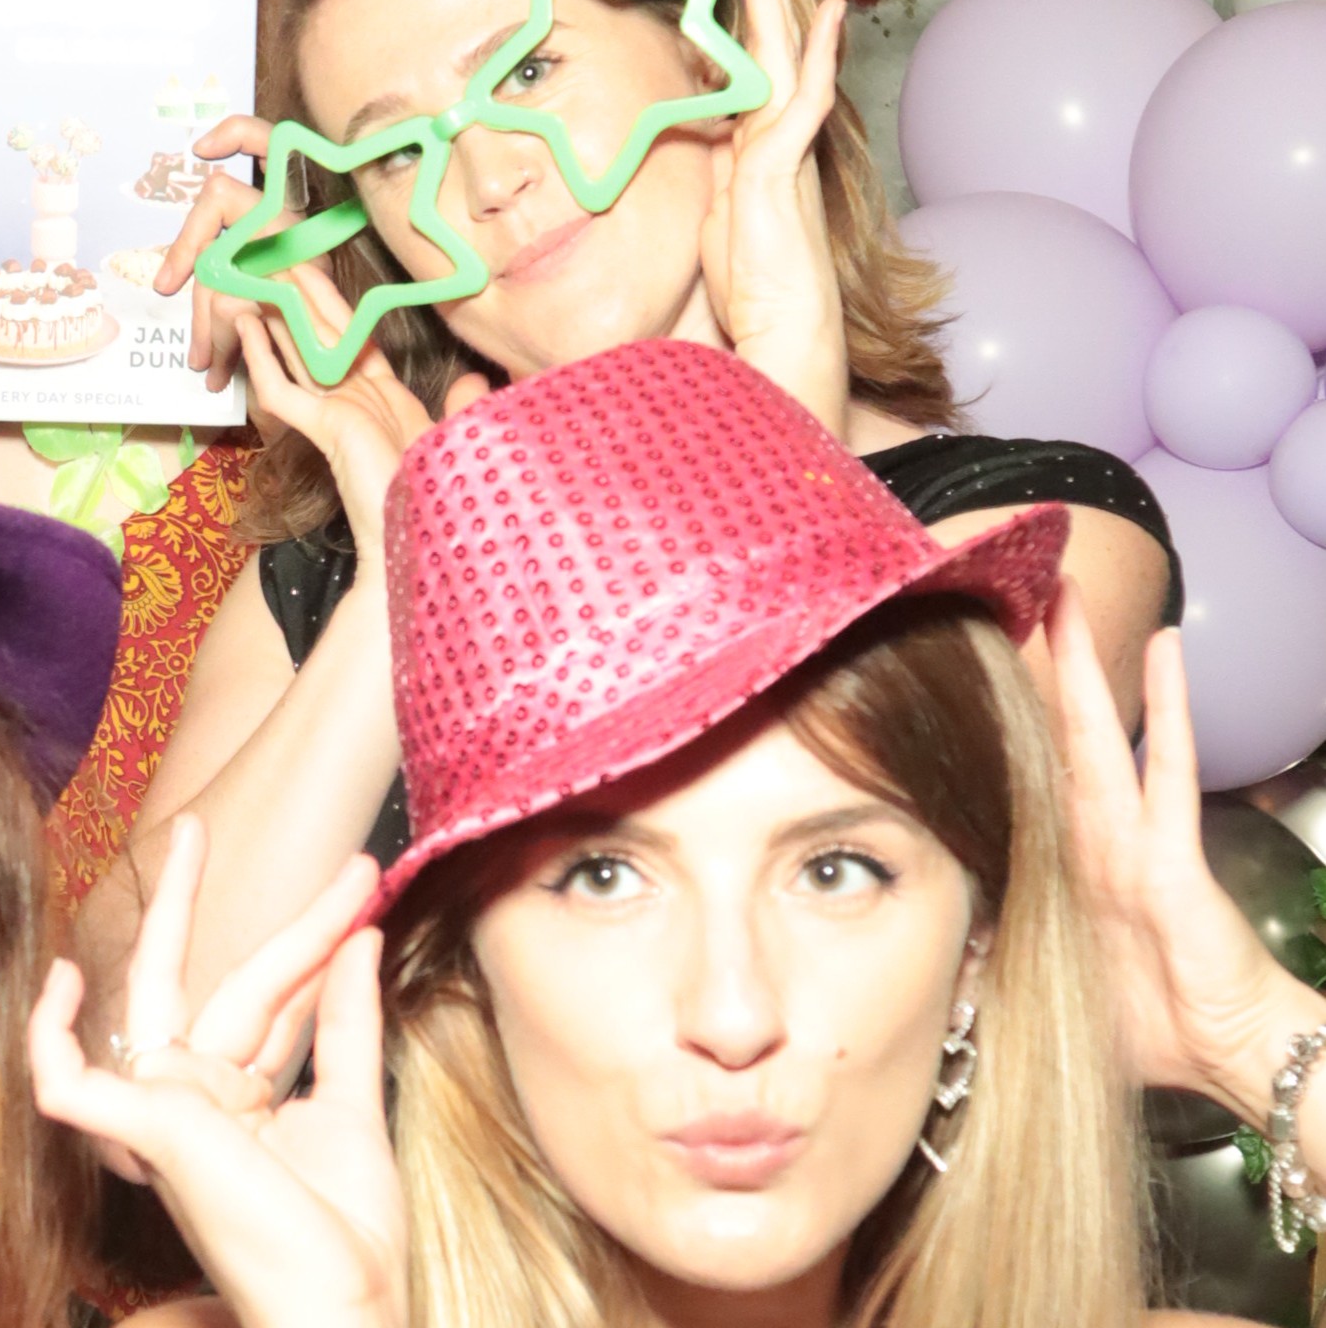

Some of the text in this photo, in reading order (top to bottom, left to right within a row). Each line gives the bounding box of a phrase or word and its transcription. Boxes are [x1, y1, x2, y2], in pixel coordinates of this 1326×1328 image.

[134, 327, 185, 344] JAN
[129, 351, 185, 368] DUN
[36, 392, 68, 404] DAY
[74, 393, 144, 406] SPECIAL
